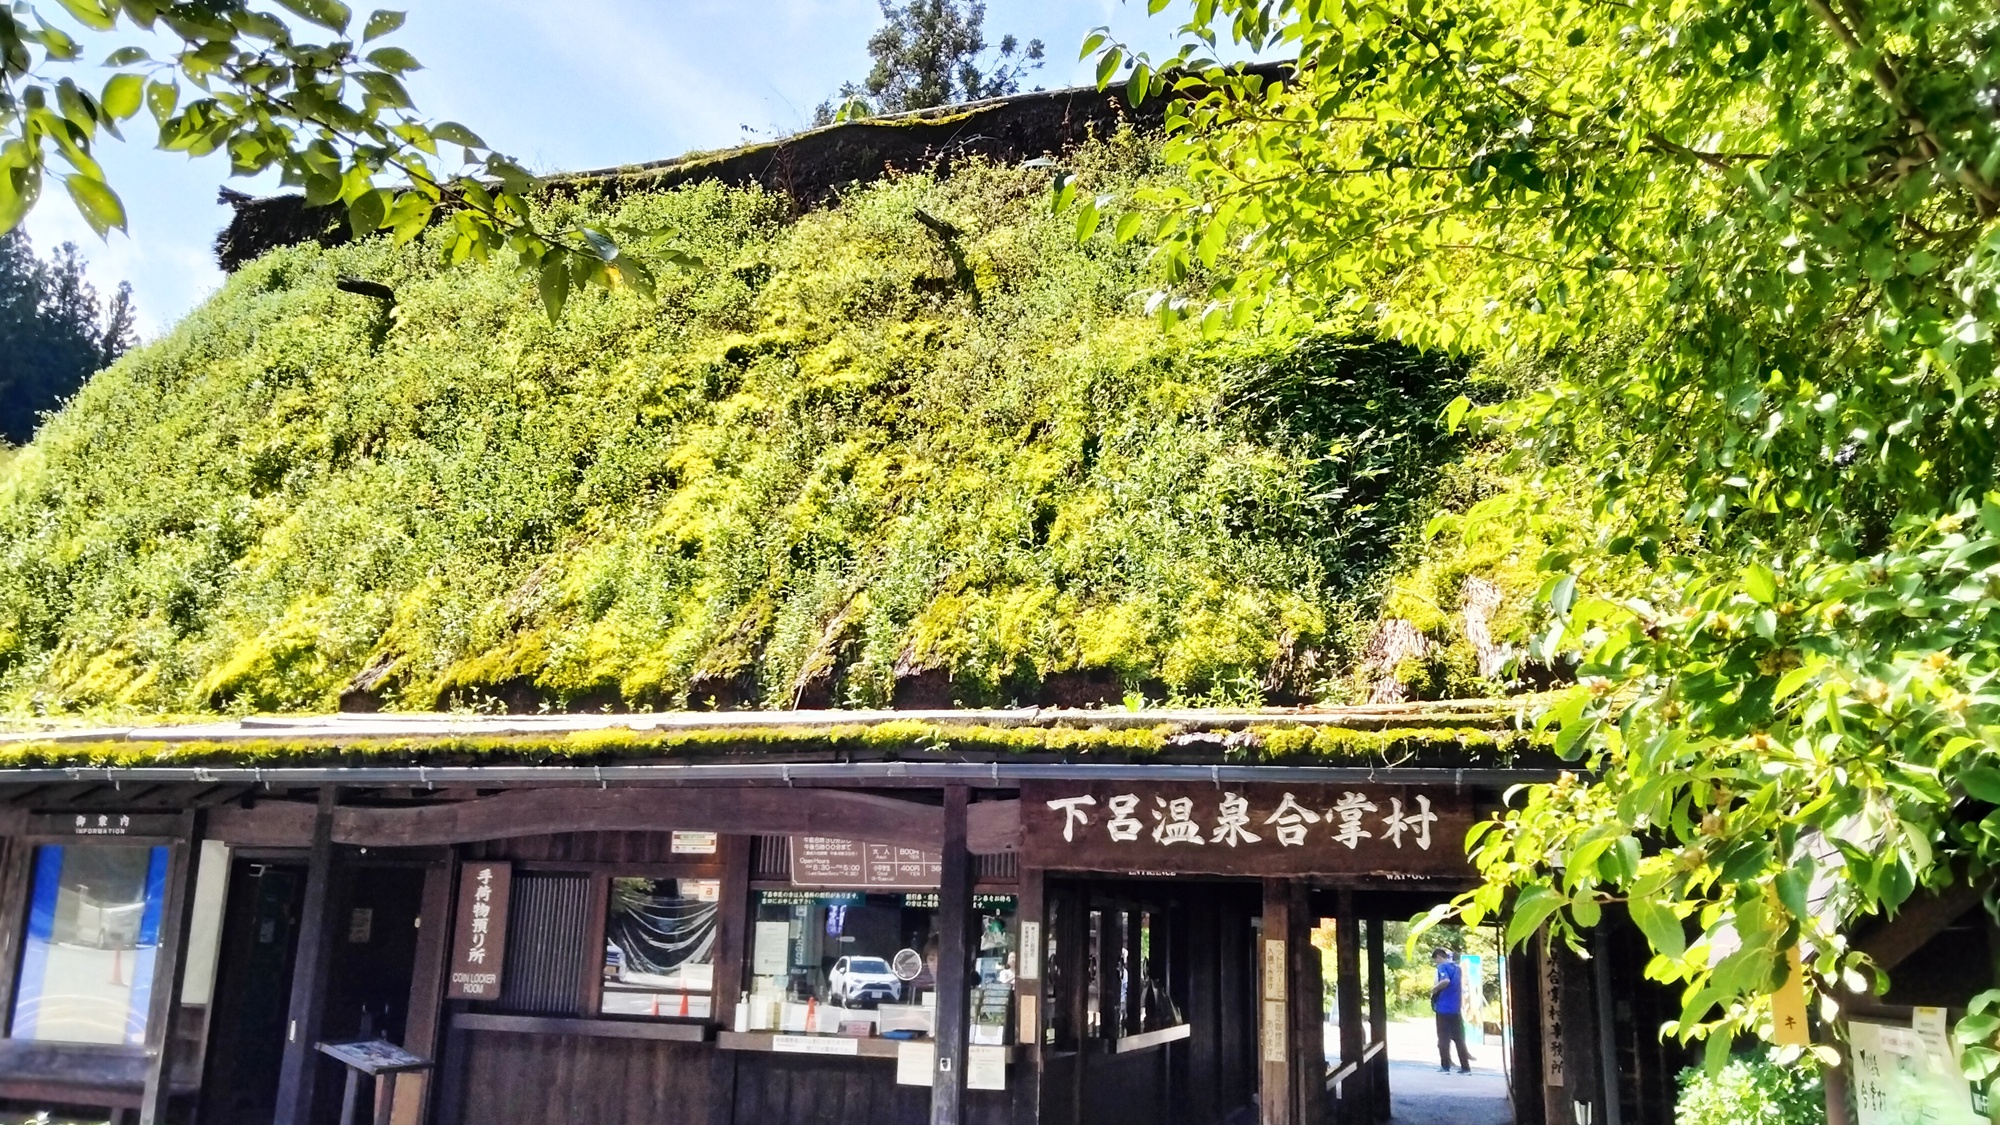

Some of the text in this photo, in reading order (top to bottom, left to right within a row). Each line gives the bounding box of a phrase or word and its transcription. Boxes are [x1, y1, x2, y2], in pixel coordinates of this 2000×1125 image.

[1046, 790, 1438, 850] 下呂温泉合掌村
[900, 864, 921, 872] 400円
[467, 868, 493, 965] 手荷物預り所
[452, 973, 496, 984] COIN LOCKER
[463, 983, 484, 993] ROOM
